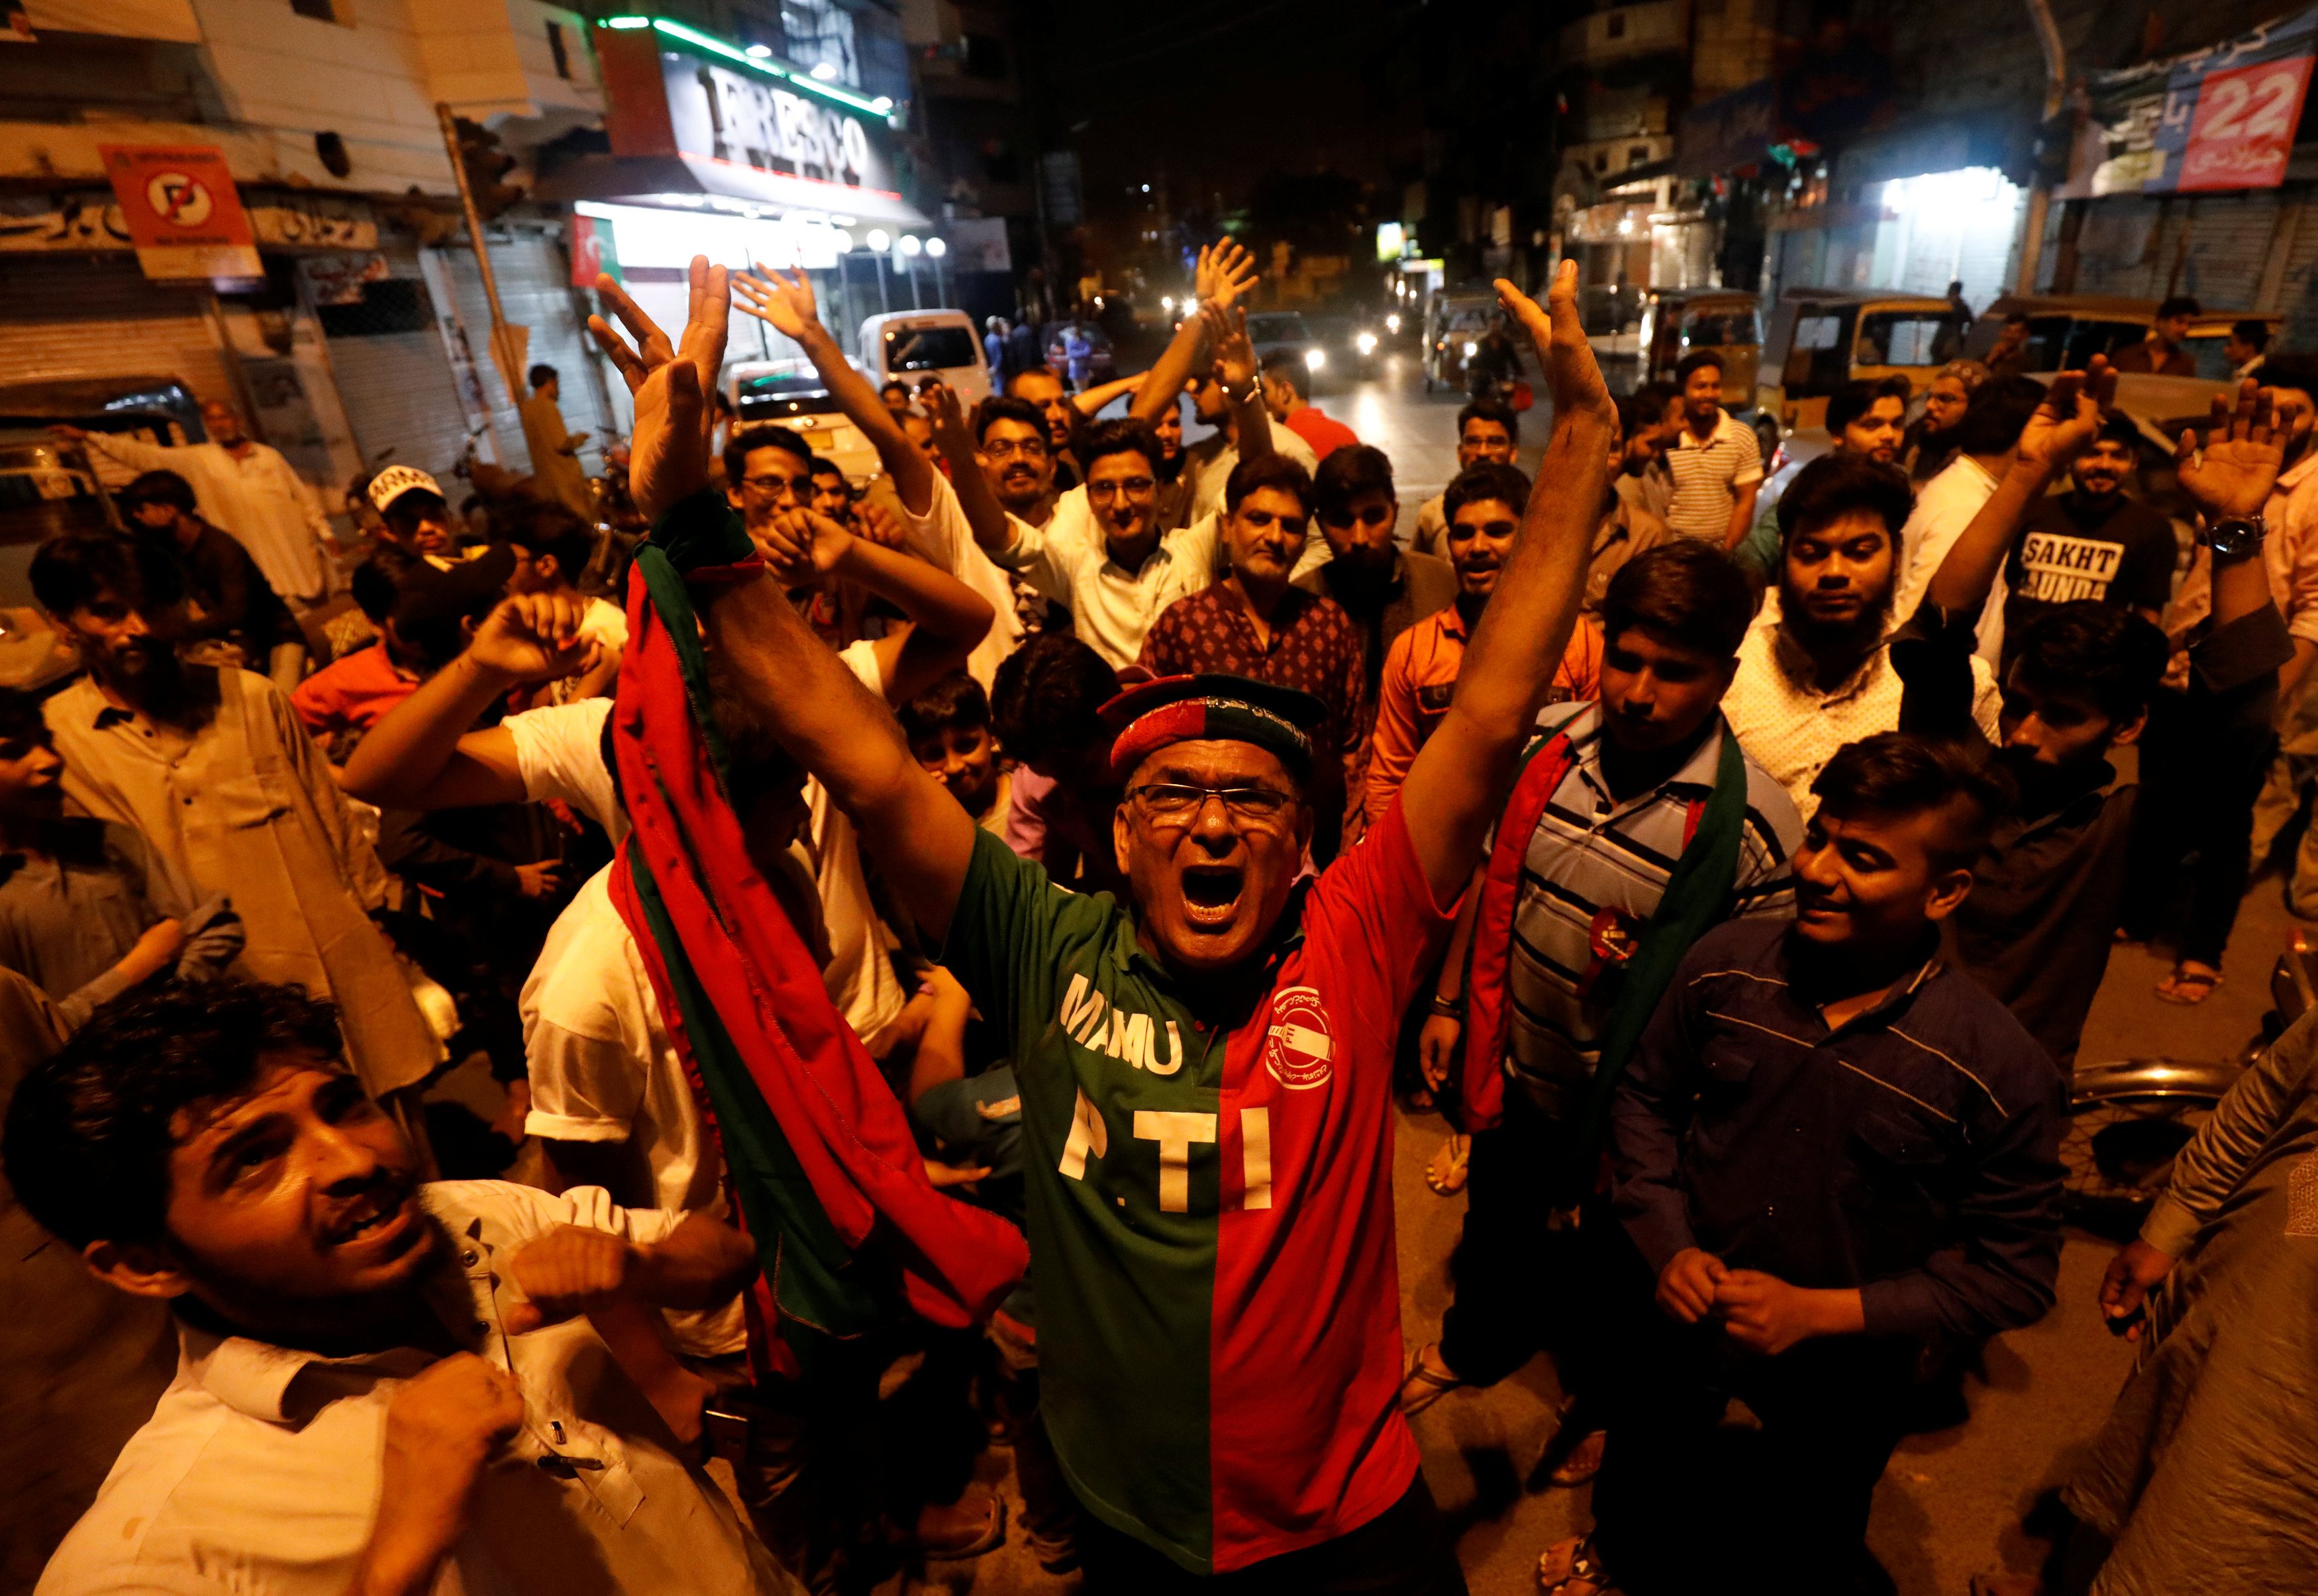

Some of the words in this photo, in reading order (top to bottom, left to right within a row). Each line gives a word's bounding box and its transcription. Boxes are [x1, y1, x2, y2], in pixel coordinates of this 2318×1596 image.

[709, 66, 868, 175] FRESCO
[2201, 73, 2298, 139] 22
[2025, 538, 2115, 574] SAKHT
[1274, 995, 1300, 1015] پاکستان
[1060, 973, 1182, 1075] MAMU
[1285, 1027, 1295, 1044] PTI
[1313, 1064, 1327, 1079] نشان
